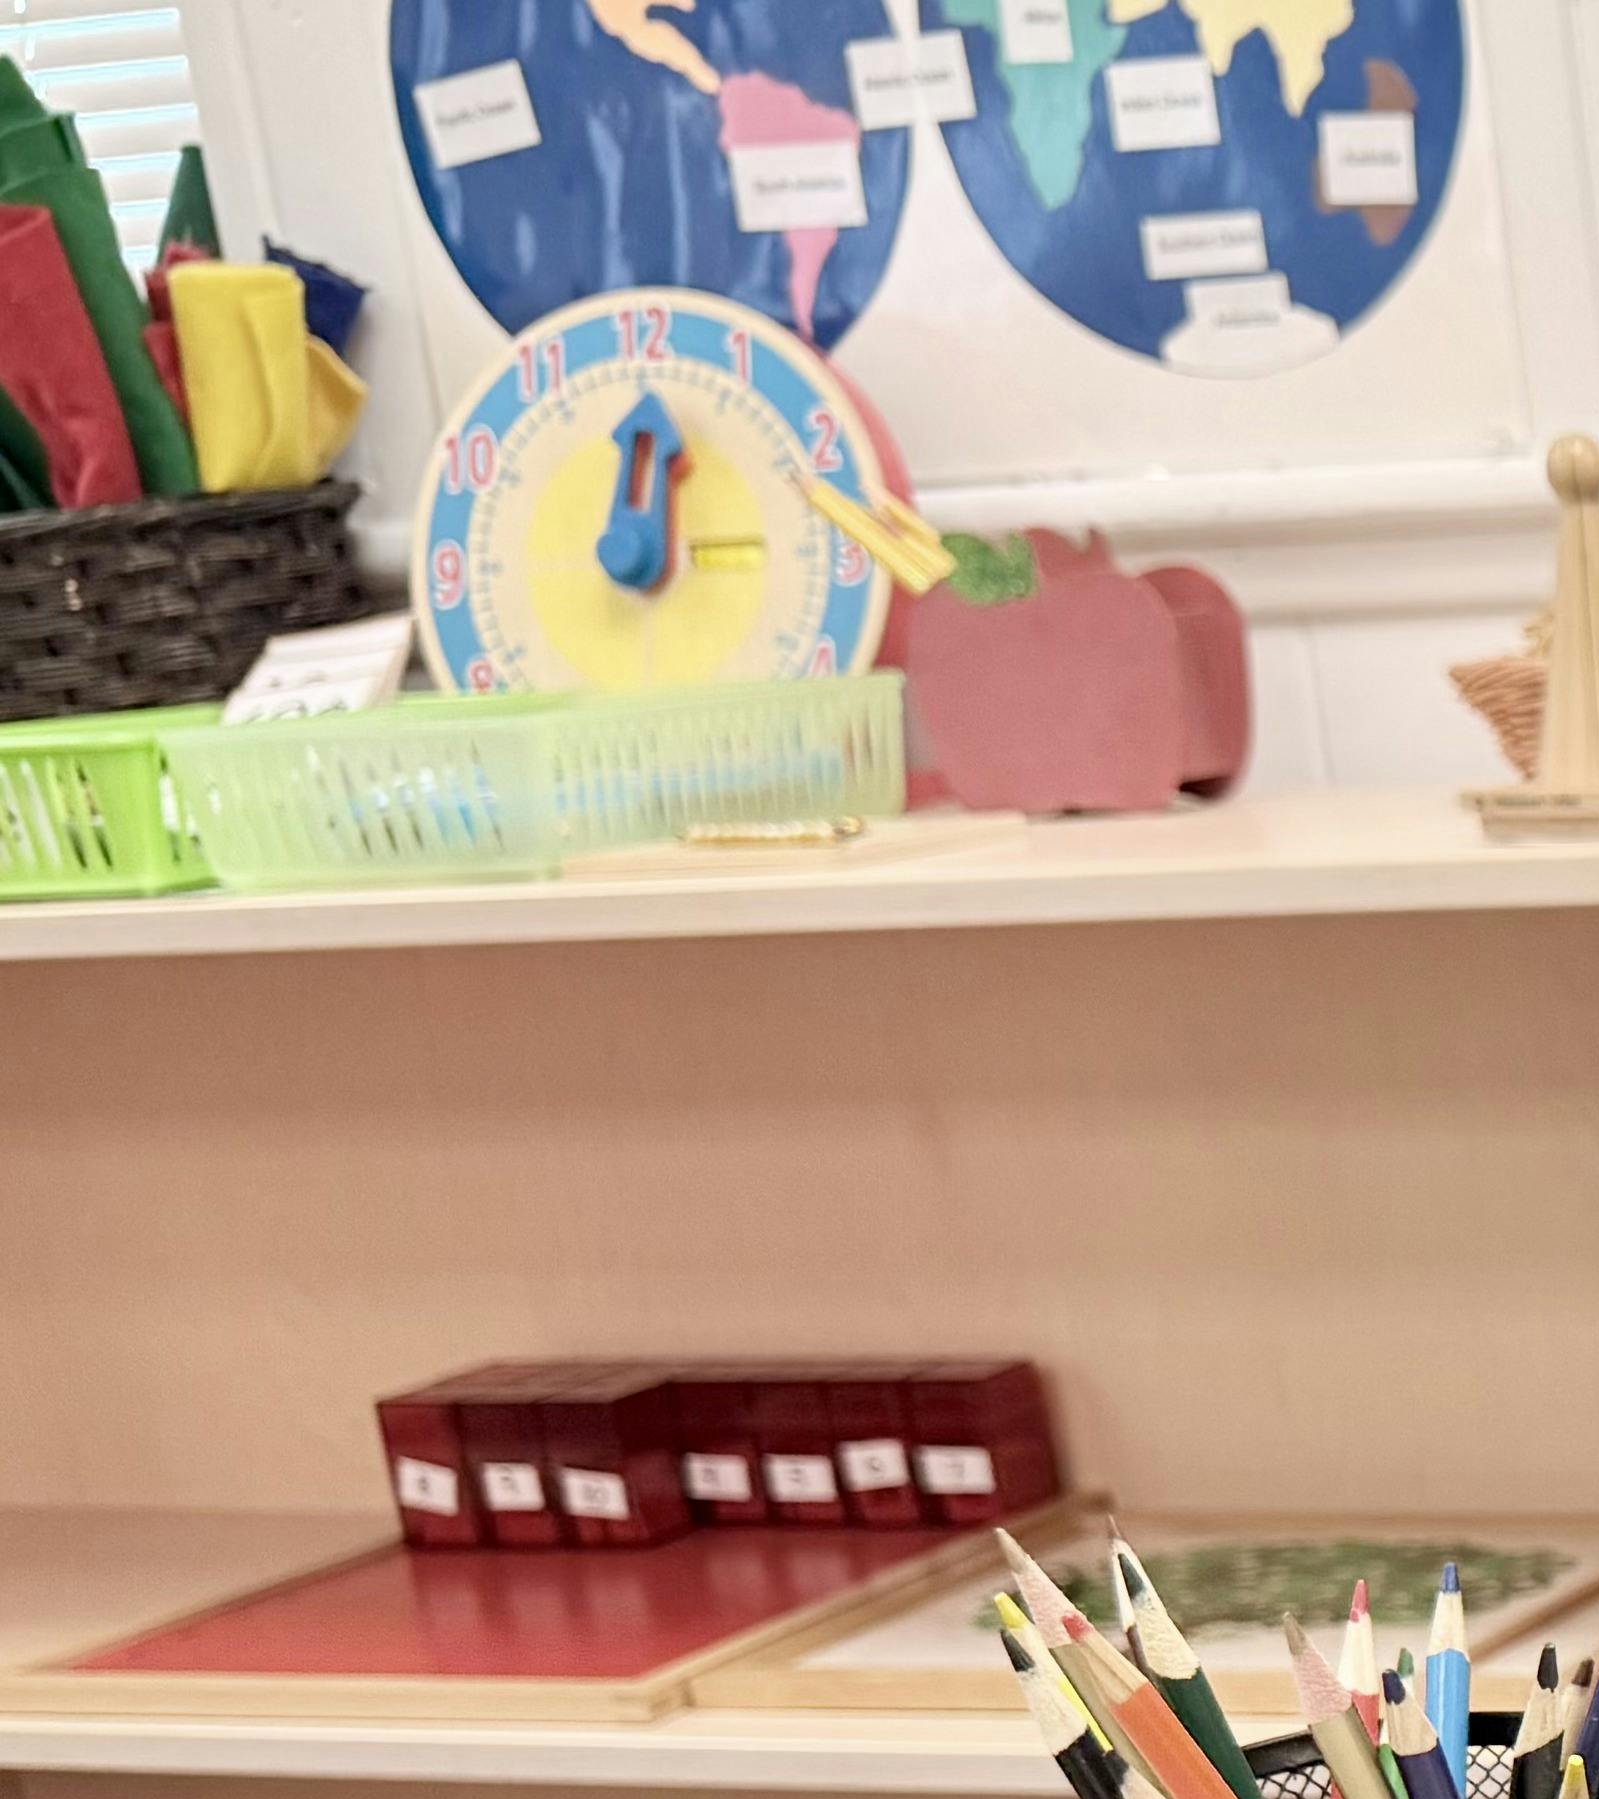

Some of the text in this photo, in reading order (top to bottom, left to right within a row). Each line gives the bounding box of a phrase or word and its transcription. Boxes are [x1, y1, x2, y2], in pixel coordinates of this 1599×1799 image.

[618, 306, 672, 362] 12
[731, 330, 749, 383] 1
[518, 343, 563, 398] 11
[445, 432, 496, 490] 10
[811, 412, 838, 469] 2
[435, 545, 462, 604] 9
